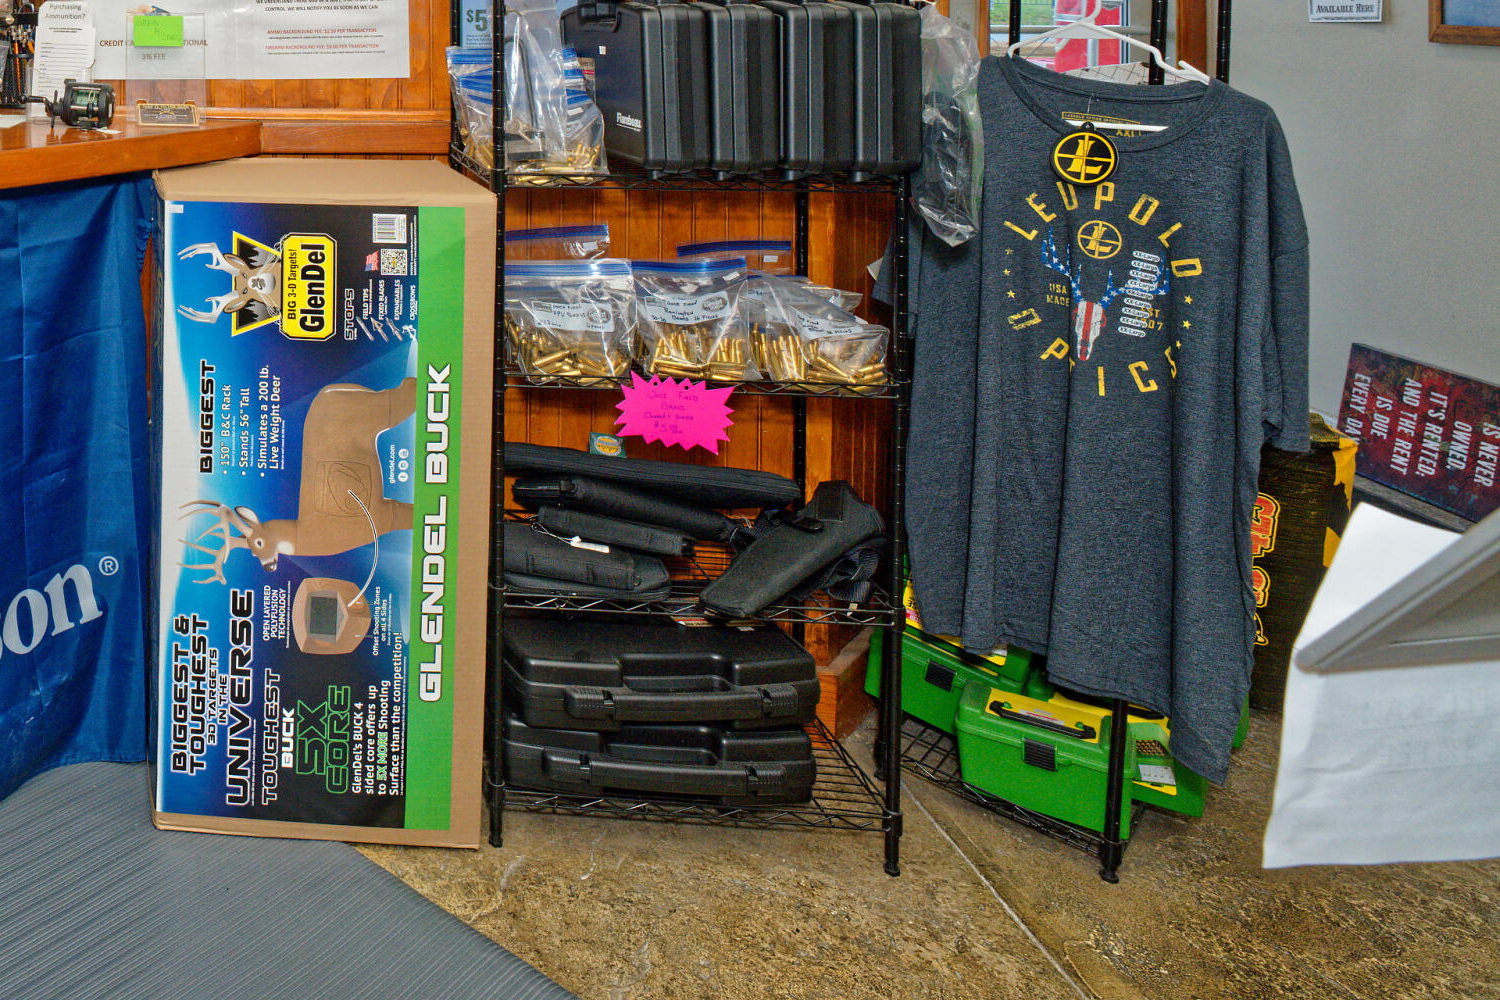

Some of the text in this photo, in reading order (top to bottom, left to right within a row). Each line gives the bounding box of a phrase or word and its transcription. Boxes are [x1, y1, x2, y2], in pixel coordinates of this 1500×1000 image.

[100, 39, 123, 47] CREDIT
[466, 9, 488, 31] $5
[1004, 181, 1203, 279] LEUPOLD
[288, 249, 299, 320] BIG 3-D Targets!
[299, 243, 326, 332] GlenDel
[344, 288, 355, 341] STOPS
[222, 384, 232, 411] Rack
[259, 381, 269, 401] 200
[260, 365, 269, 379] lb.
[1350, 373, 1371, 414] EVERY
[200, 359, 215, 474] BIGGEST
[221, 412, 230, 437] B&C
[269, 375, 282, 469] Live Weight Deer
[1370, 396, 1393, 440] IS DUE
[1390, 378, 1422, 475] AND THE RENT
[1427, 392, 1448, 420] IT'S
[239, 429, 249, 468] Stands
[258, 415, 268, 469] Simulates
[1473, 422, 1500, 487] IS NEVER
[419, 364, 451, 702] GLENDEL BUCK
[278, 588, 286, 639] TECHNOLOGY
[171, 614, 190, 773] BIGGEST &
[189, 614, 208, 775] TOUGHEST
[207, 648, 218, 745] 3D TARGETS
[218, 674, 228, 725] IN THE
[227, 588, 254, 806] UNIVERSE
[366, 706, 376, 738] offers
[369, 685, 378, 700] up
[390, 632, 405, 796] Surface than the competition!
[262, 668, 280, 805] TOUGHEST
[282, 707, 295, 768] BUCK
[296, 700, 327, 775] 5X
[326, 685, 350, 794] CORE
[352, 702, 363, 794] GlenDel's BUCK 4
[378, 680, 391, 795] to 5X MORE Shooting
[364, 763, 374, 795] sided
